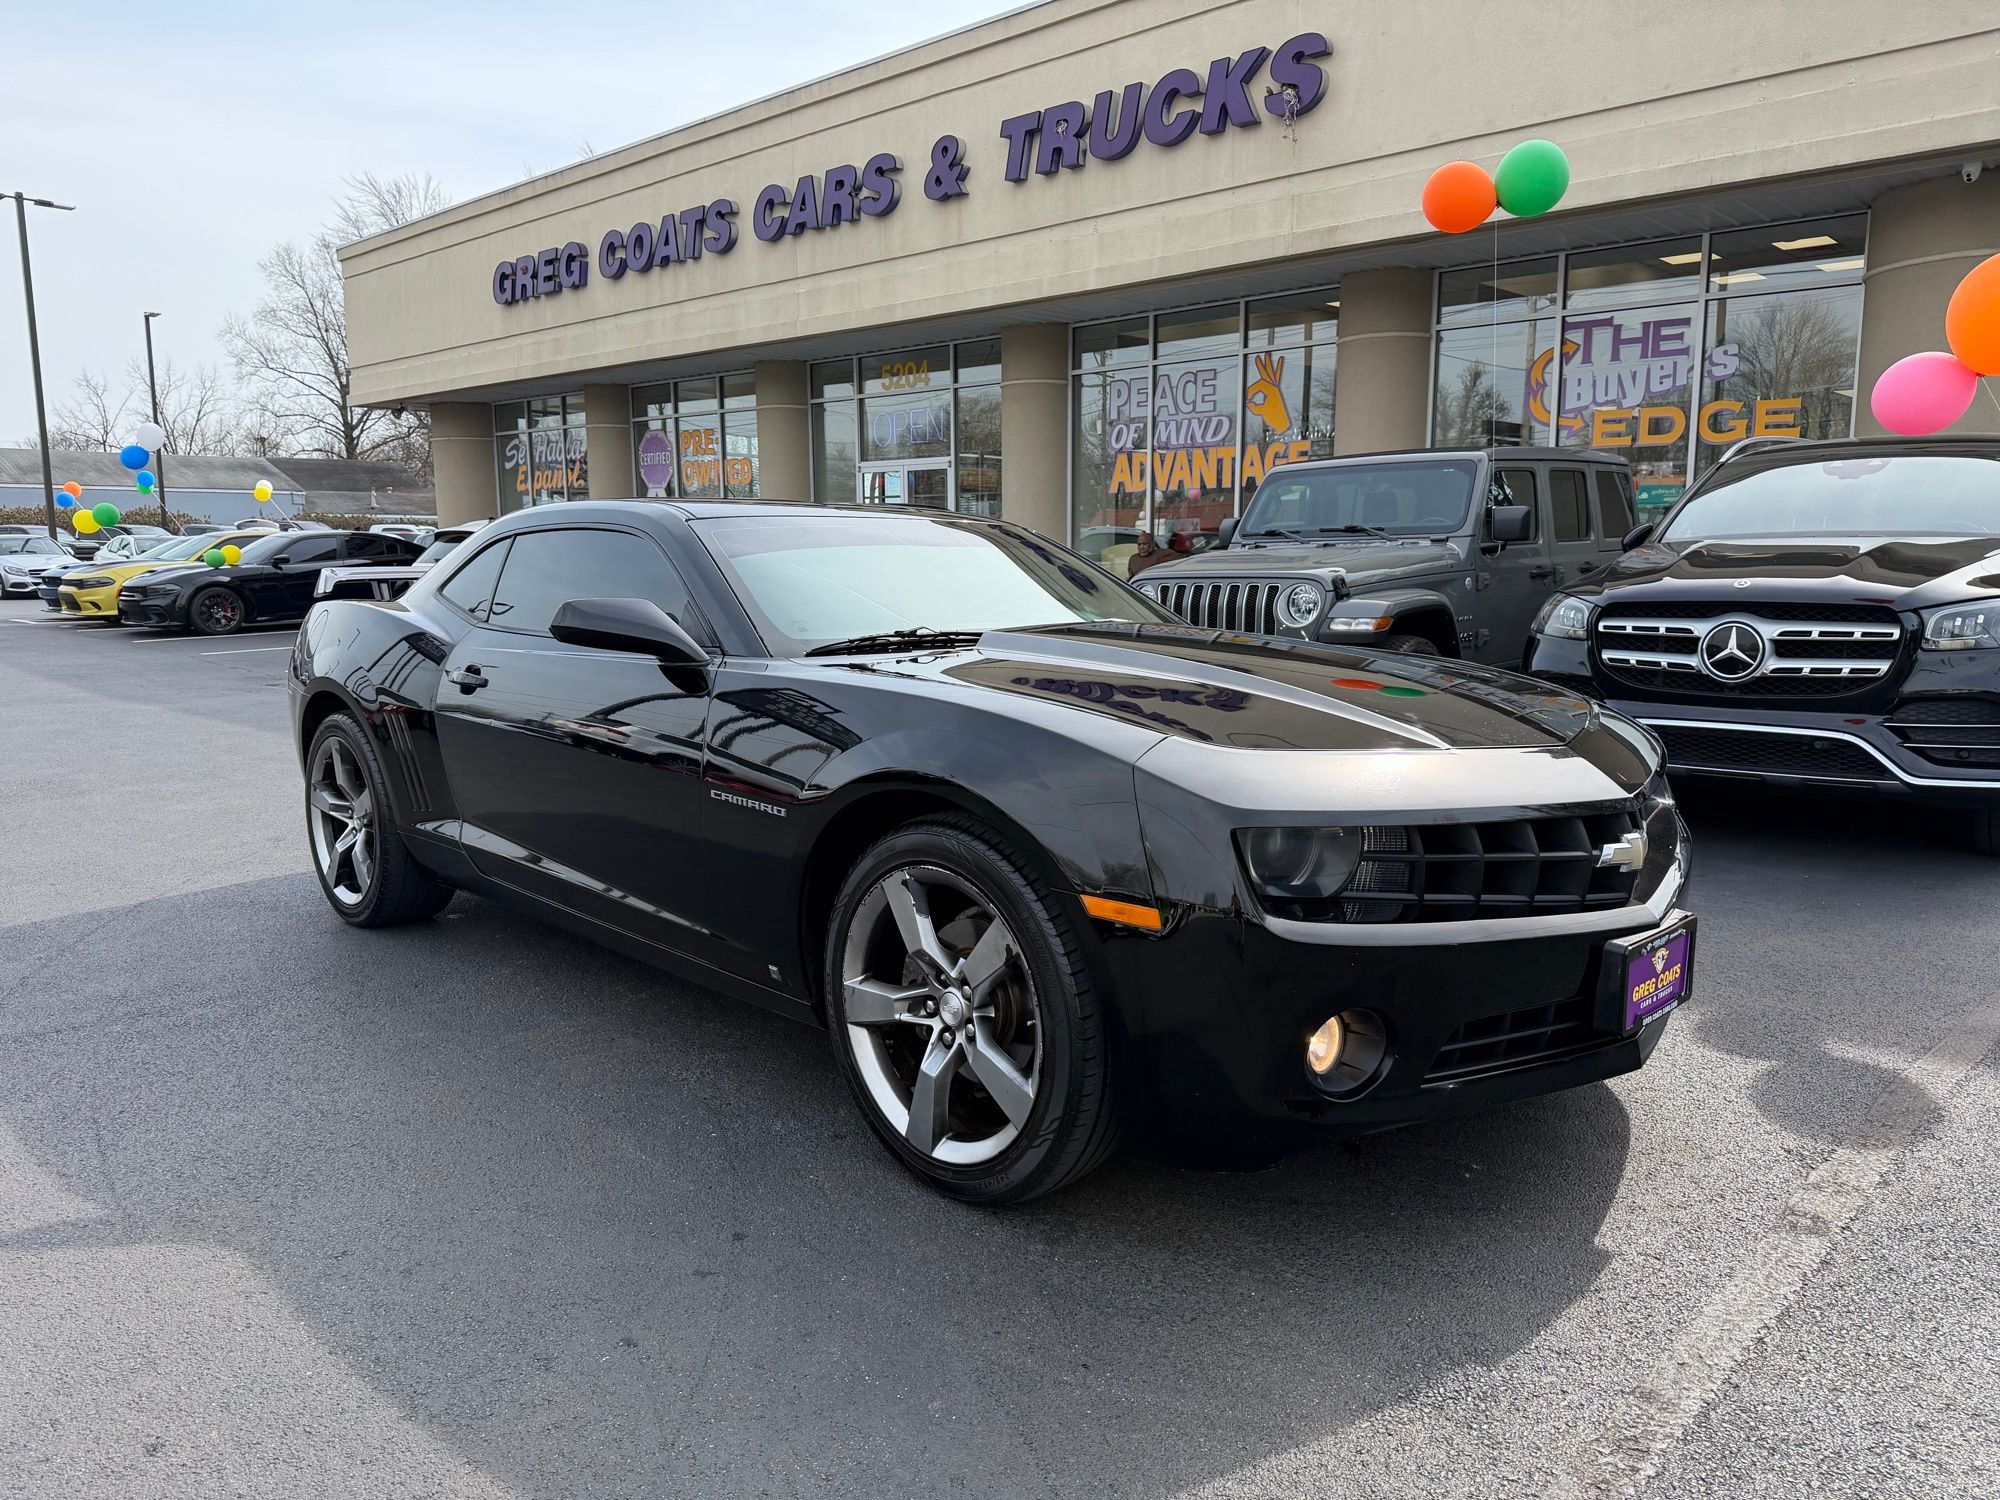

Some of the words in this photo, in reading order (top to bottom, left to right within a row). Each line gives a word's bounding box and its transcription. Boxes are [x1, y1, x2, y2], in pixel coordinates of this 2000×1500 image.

[493, 241, 588, 305] GREG
[599, 198, 739, 279] COATS
[753, 152, 903, 242] CARS
[924, 134, 971, 201] &
[1000, 32, 1334, 183] TRUCKS
[1564, 315, 1692, 366] THE
[880, 360, 930, 391] 5204
[1109, 368, 1217, 421] PEACE
[1564, 343, 1741, 411] Buyers
[680, 428, 719, 457] PRE-
[873, 406, 945, 448] OPEN
[1109, 421, 1145, 451] OF
[1153, 415, 1232, 448] MIND
[1590, 396, 1802, 449] EDGE
[504, 438, 527, 470] Se
[640, 451, 671, 466] CERTIFIED
[1109, 439, 1312, 494] ADVANTAGE
[710, 789, 787, 817] CAMARO
[1632, 977, 1656, 1002] GREG
[1657, 963, 1681, 989] COATS
